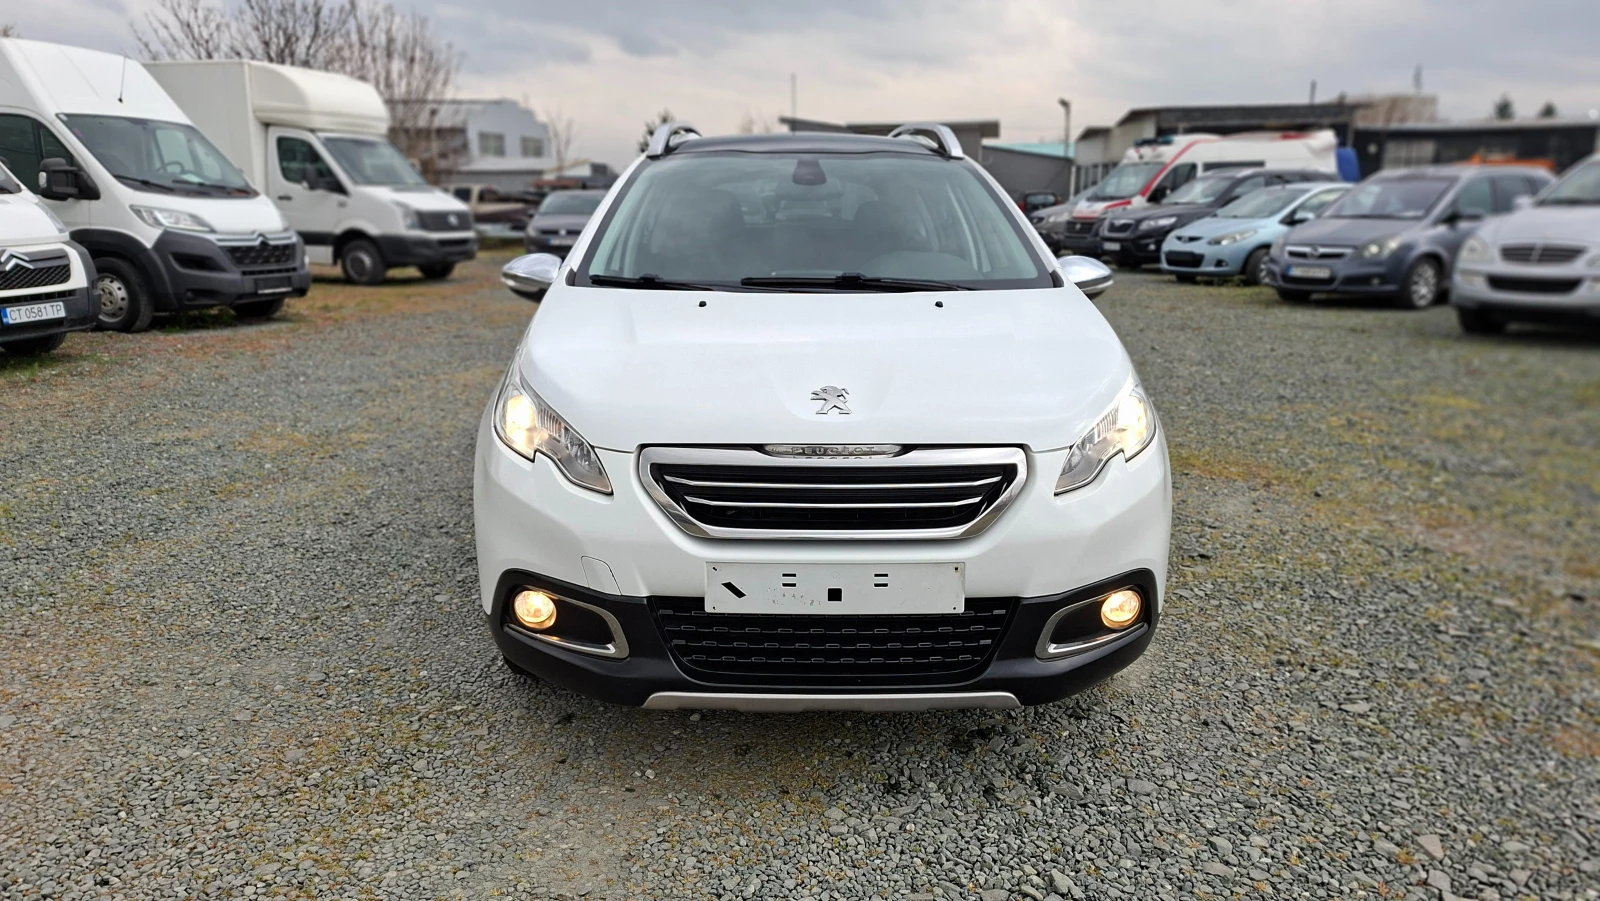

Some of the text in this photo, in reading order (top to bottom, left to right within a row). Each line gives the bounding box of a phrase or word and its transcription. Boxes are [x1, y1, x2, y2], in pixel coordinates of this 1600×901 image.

[9, 304, 62, 321] CT 0581 TP
[791, 446, 875, 454] PEUGEOT
